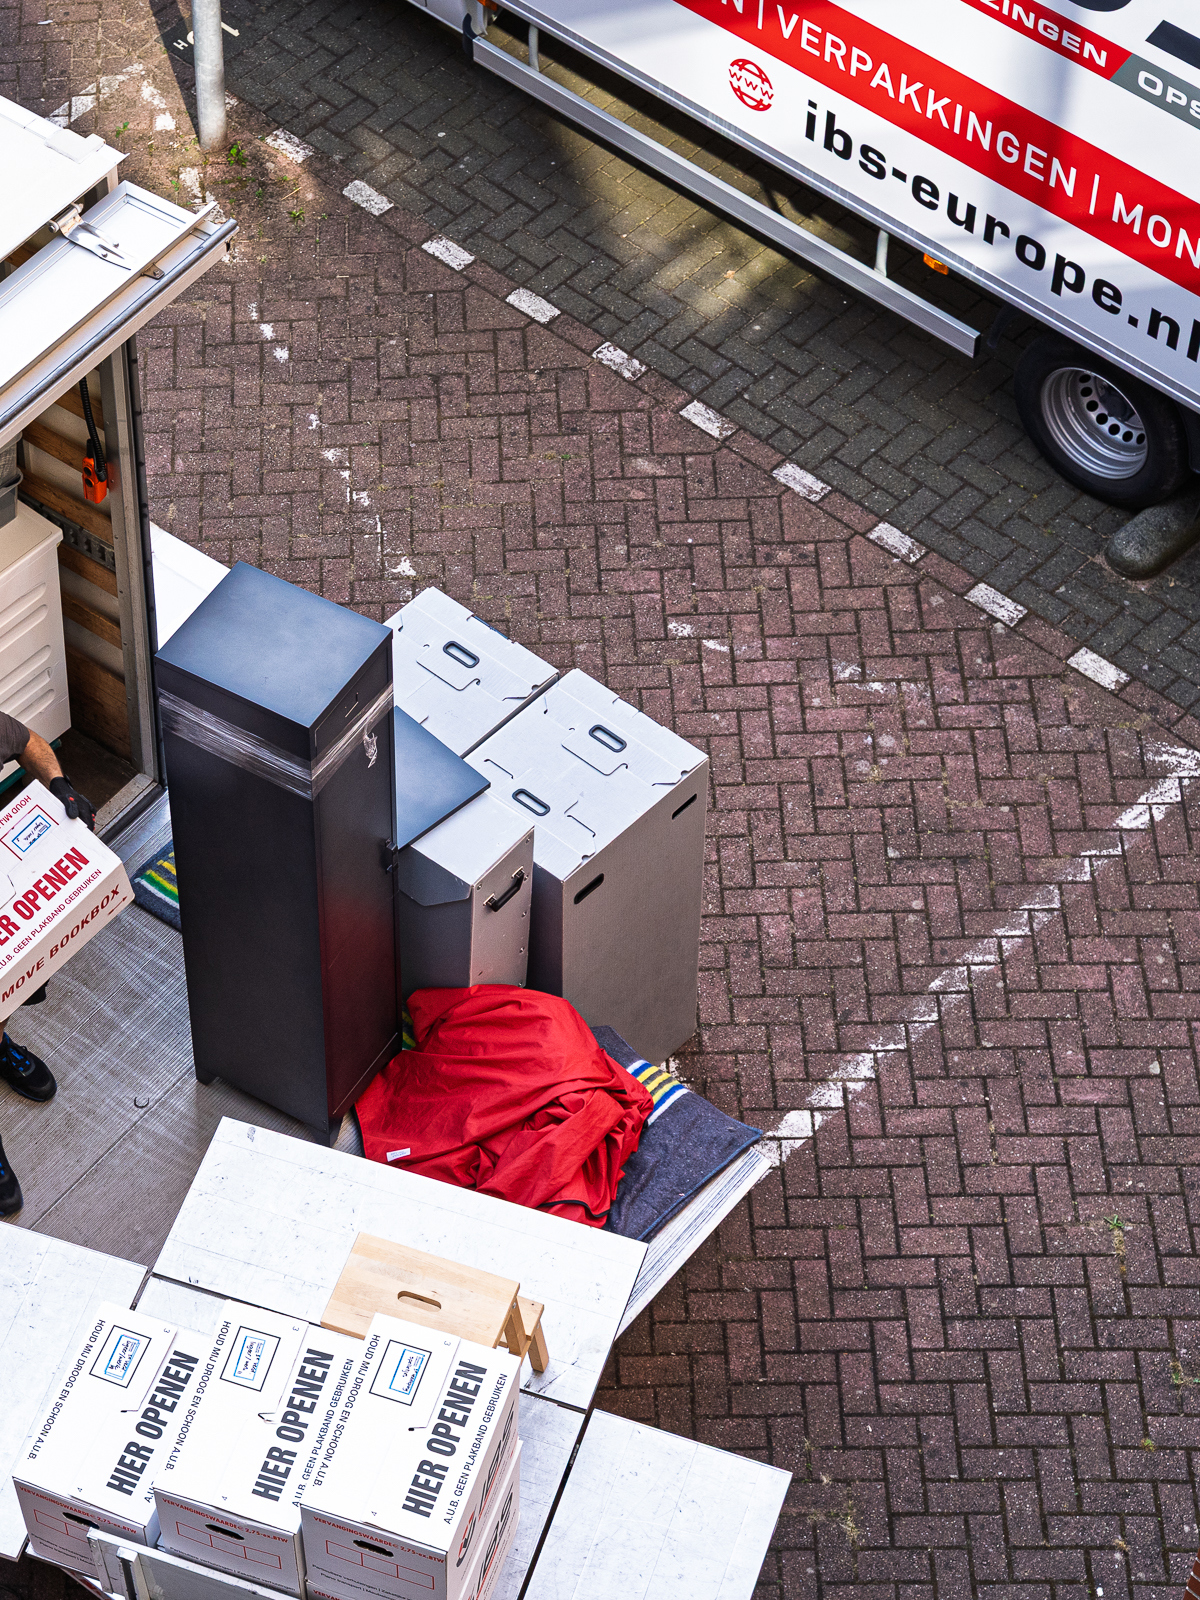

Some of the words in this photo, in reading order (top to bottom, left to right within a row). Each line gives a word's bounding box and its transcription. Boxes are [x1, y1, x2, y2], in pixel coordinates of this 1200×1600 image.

[981, 0, 1106, 68] INGEN
[777, 3, 1077, 198] VERPAKKINGEN
[805, 100, 1200, 363] ibs-europe.nl
[0, 812, 13, 827] MIJ
[13, 795, 31, 815] HOUD
[12, 847, 89, 921] OPENEN
[14, 936, 32, 954] GEEN
[31, 903, 66, 938] PLAKBAND
[65, 869, 102, 905] GEBRUIKEN
[2, 957, 45, 1002] MOVE
[49, 884, 120, 959] BOOKBOX
[89, 1319, 105, 1343] HOUD
[215, 1320, 231, 1346] HOUD
[365, 1334, 380, 1359] HOUD
[80, 1343, 93, 1358] MIJ
[208, 1346, 221, 1362] MIJ
[65, 1358, 85, 1388] DROOG
[196, 1362, 214, 1394] DROOG
[357, 1360, 370, 1377] MIJ
[58, 1389, 70, 1401] EN
[190, 1395, 201, 1408] EN
[345, 1377, 364, 1409] DROOG
[40, 1401, 64, 1436] SCHOON
[106, 1441, 154, 1496] HIER
[135, 1350, 200, 1440] OPENEN
[175, 1409, 196, 1446] SCHOON
[252, 1446, 297, 1502] HIER
[276, 1348, 334, 1443] OPENEN
[340, 1410, 350, 1423] EN
[27, 1436, 44, 1460] A.U.B.
[291, 1483, 306, 1508] A.U.B.
[301, 1456, 317, 1480] GEEN
[311, 1409, 334, 1456] PLAKBAND
[329, 1358, 354, 1408] GEBRUIKEN
[326, 1424, 345, 1462] SCHOON
[401, 1459, 449, 1518] HIER
[426, 1360, 487, 1457] OPENEN
[443, 1499, 460, 1524] A.U.B.
[453, 1472, 469, 1497] GEEN
[464, 1424, 487, 1472] PLAKBAND
[482, 1373, 508, 1423] GEBRUIKEN
[164, 1446, 181, 1471] A.U.B.
[312, 1462, 328, 1487] A.U.B.
